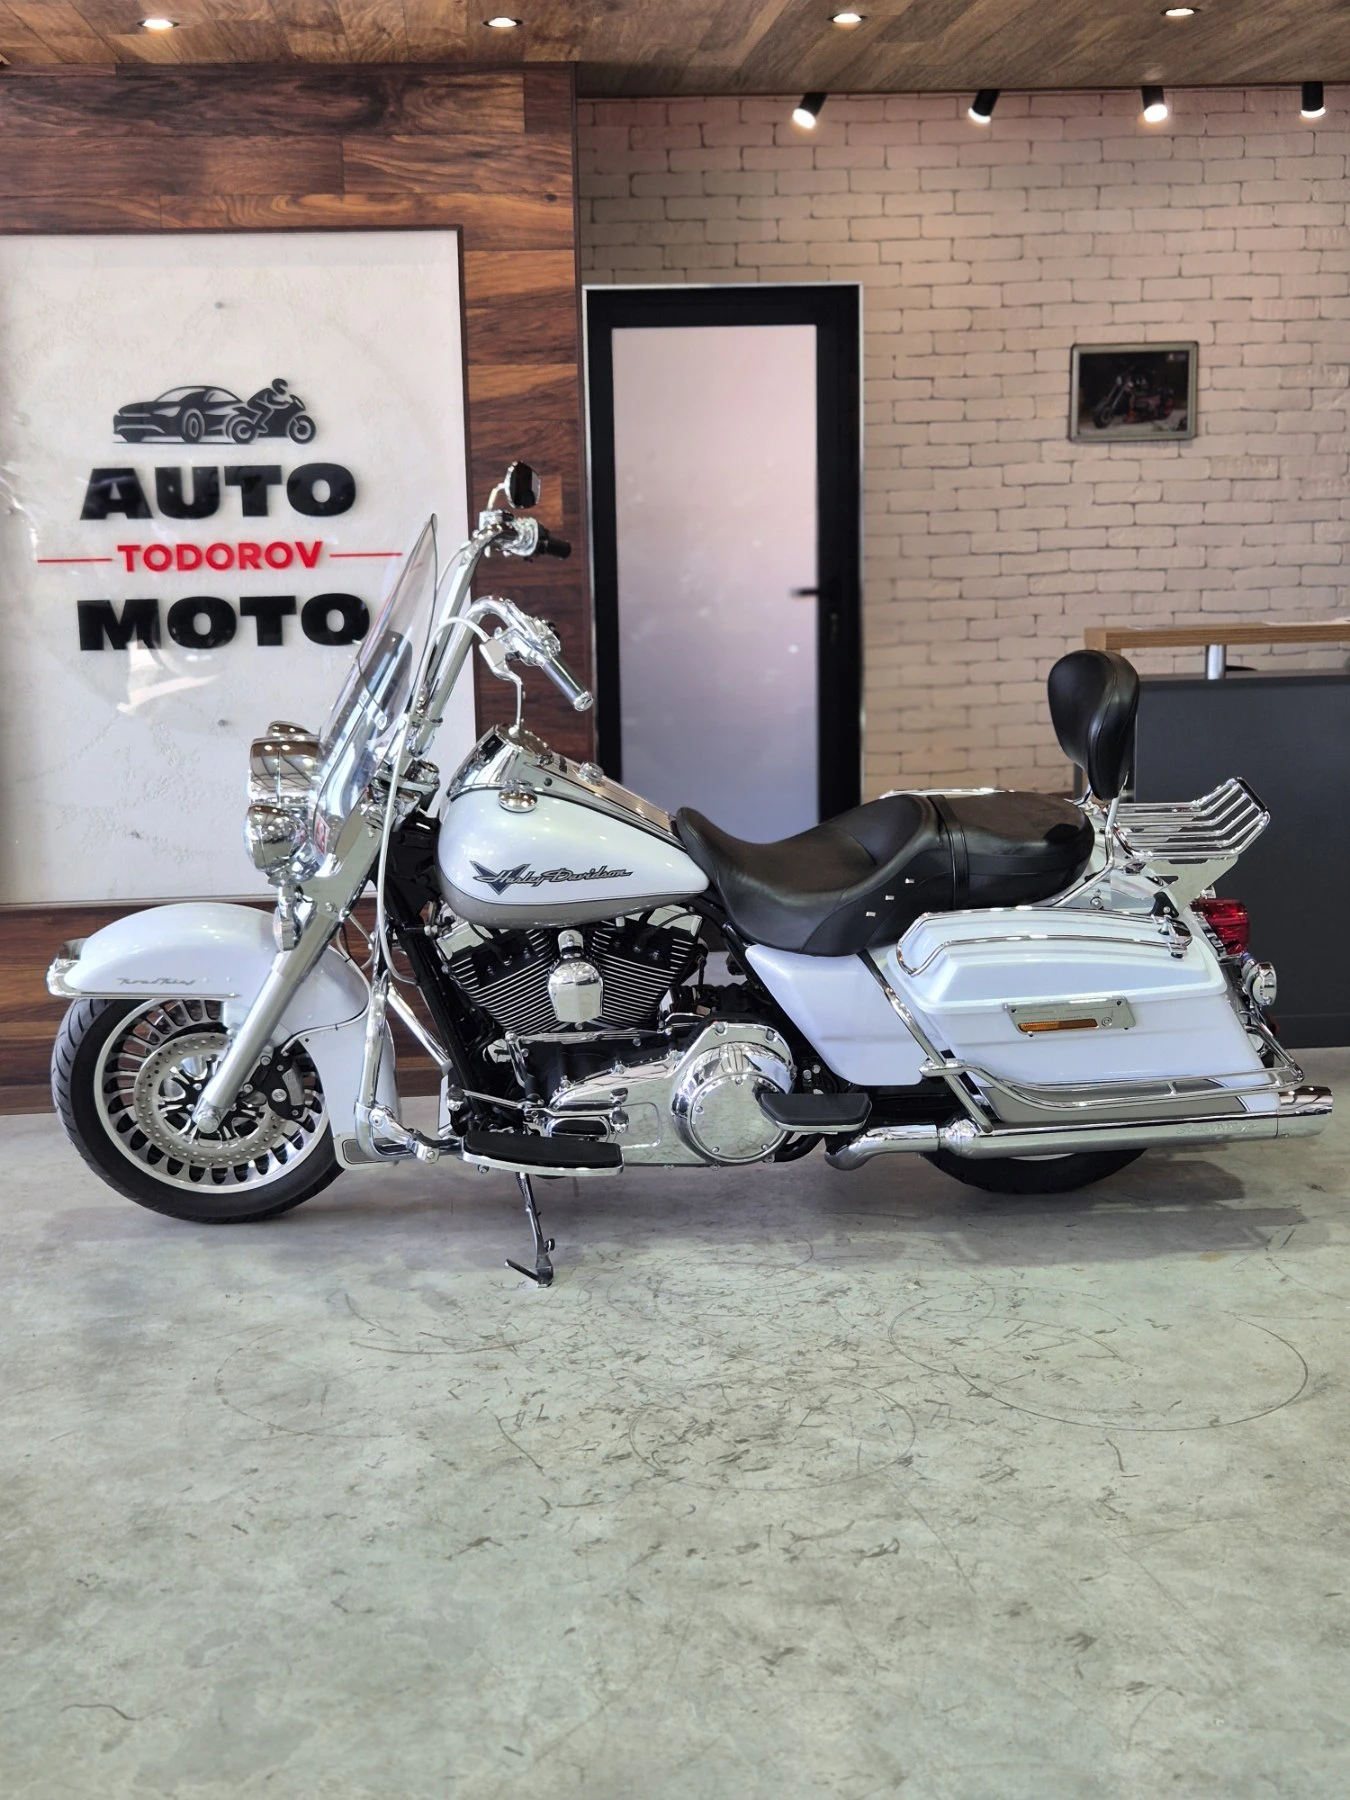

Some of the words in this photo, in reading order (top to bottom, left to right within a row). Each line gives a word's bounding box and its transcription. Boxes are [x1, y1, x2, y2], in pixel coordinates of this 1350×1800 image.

[80, 463, 357, 521] AUTO
[117, 541, 324, 573] TODOROV
[77, 593, 371, 652] MOTO
